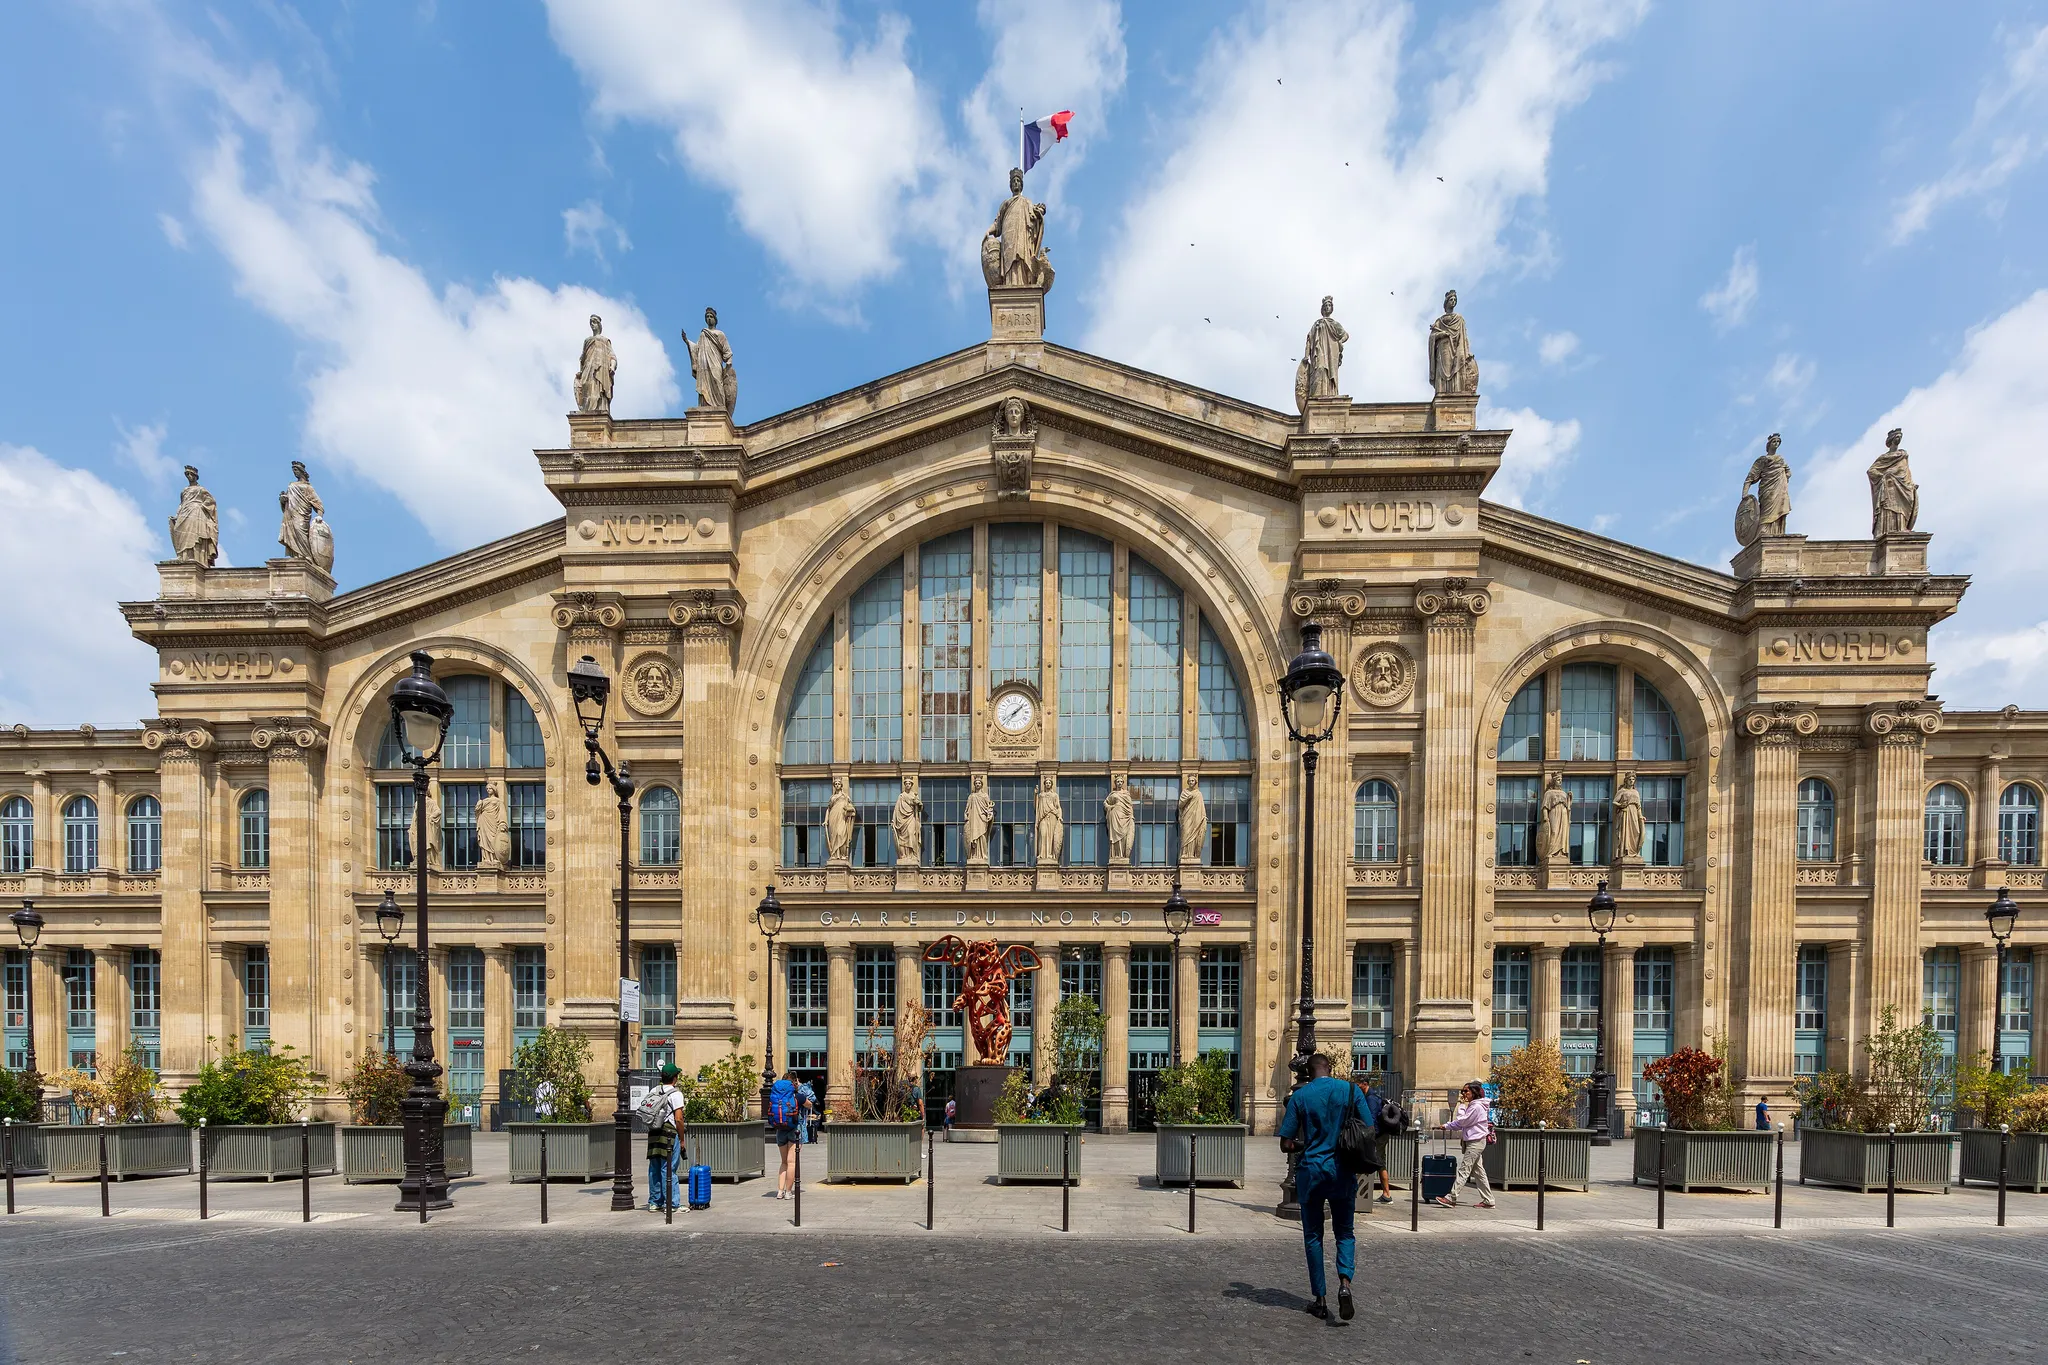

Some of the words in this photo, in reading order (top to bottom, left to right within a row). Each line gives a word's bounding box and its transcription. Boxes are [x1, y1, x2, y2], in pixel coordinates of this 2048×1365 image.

[999, 313, 1032, 327] PARIS
[601, 512, 691, 545] NORD
[1342, 500, 1437, 533] NORD
[1791, 631, 1890, 662] NORD
[189, 651, 274, 681] NORD
[820, 911, 918, 926] GARE
[956, 911, 996, 926] DU
[1031, 911, 1132, 926] NORD
[1194, 913, 1222, 924] SNCF
